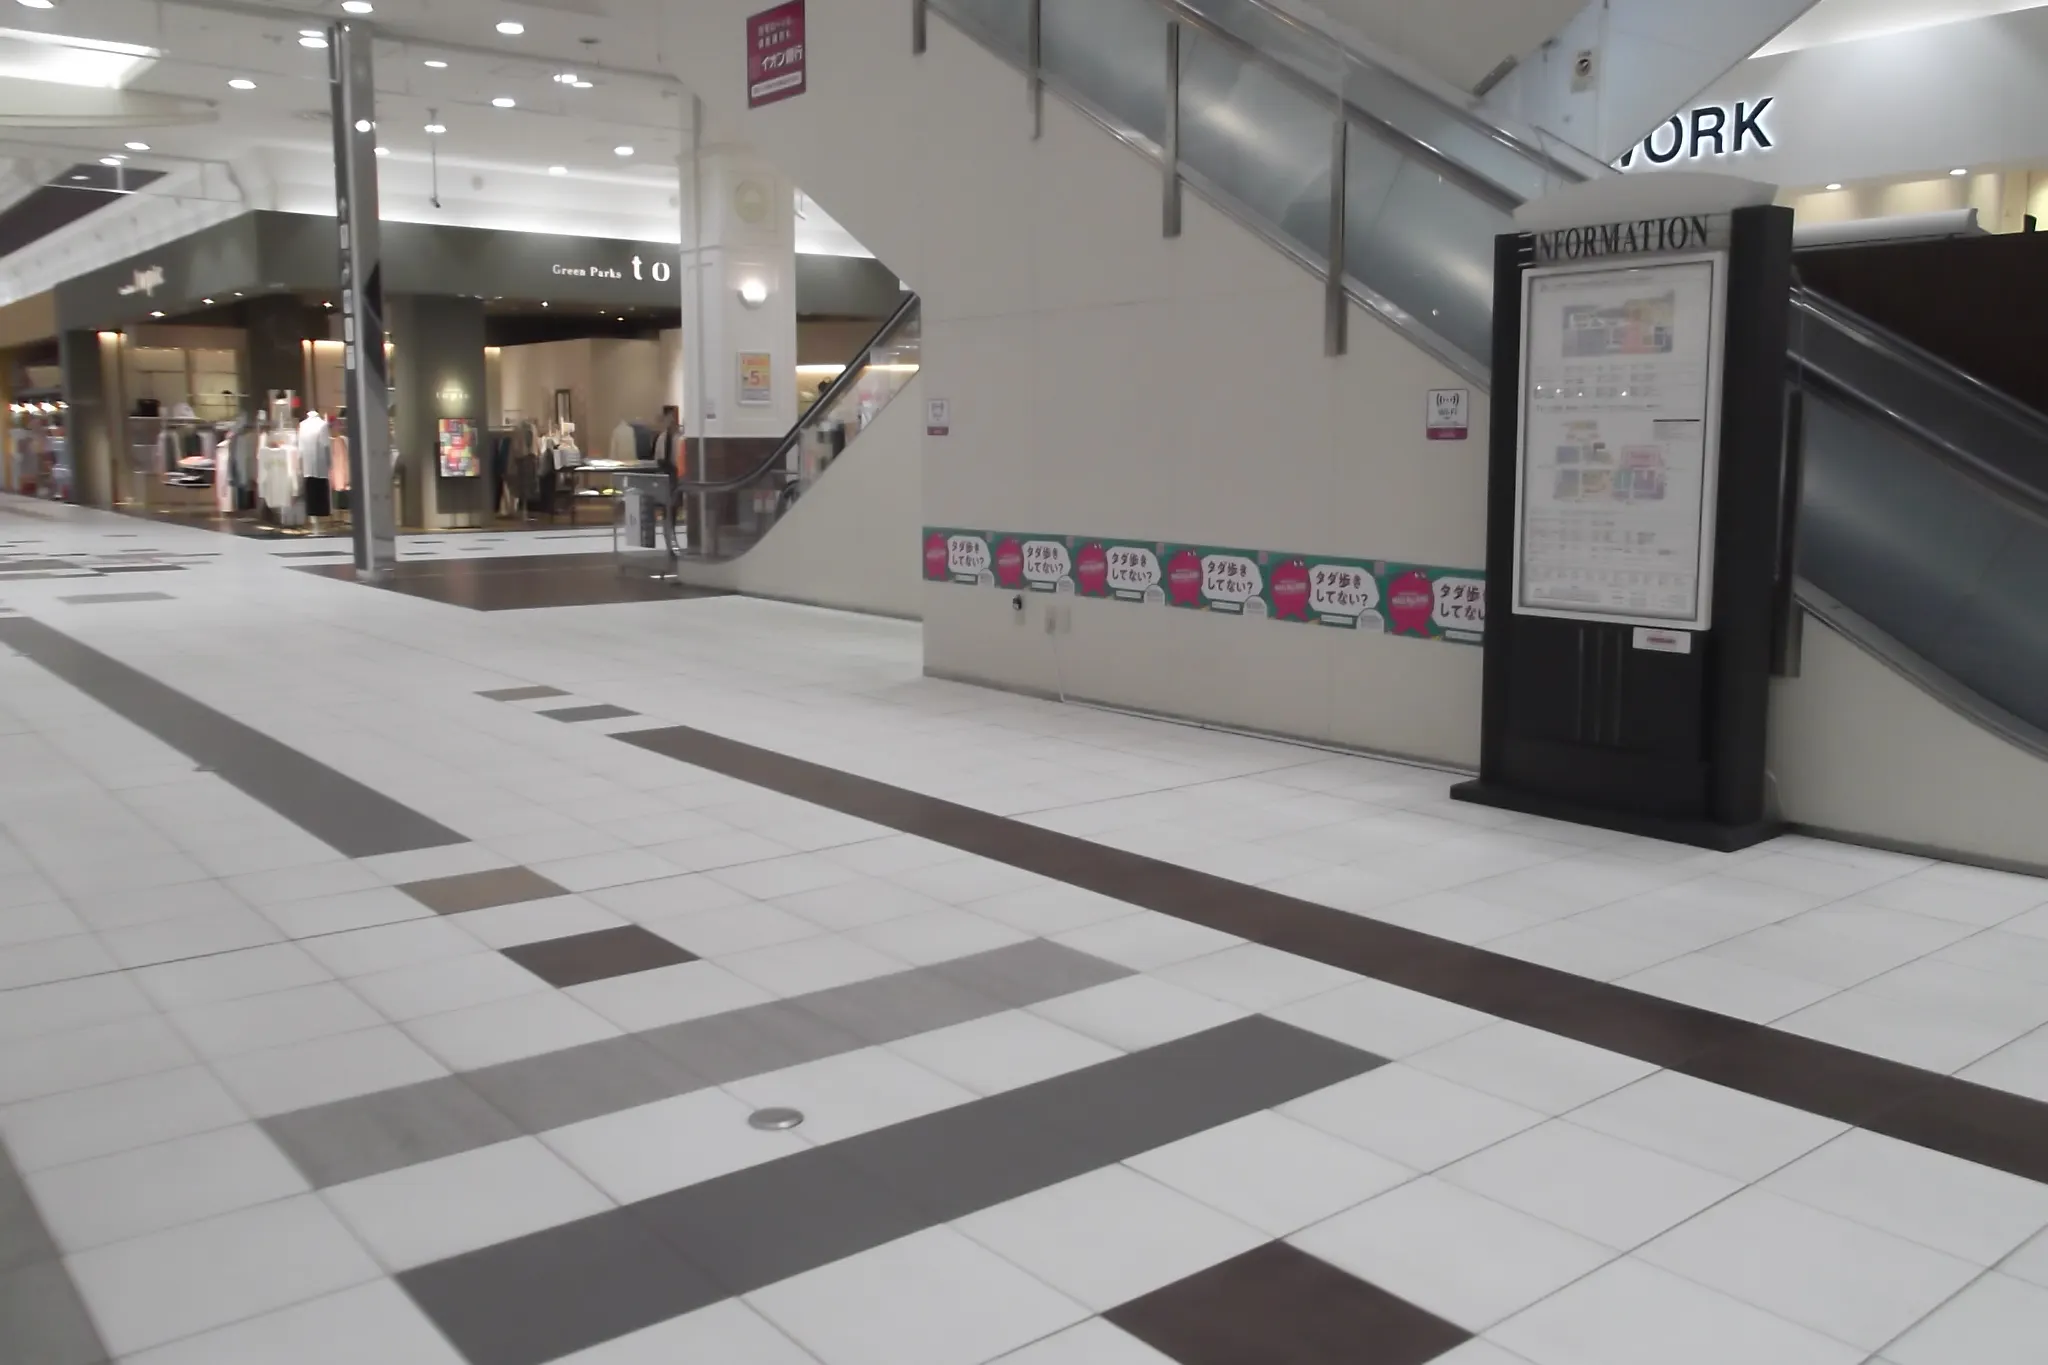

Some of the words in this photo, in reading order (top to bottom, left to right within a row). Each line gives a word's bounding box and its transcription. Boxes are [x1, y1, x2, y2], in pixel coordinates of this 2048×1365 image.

[1620, 97, 1775, 168] ORK
[552, 263, 587, 277] Green
[589, 266, 622, 279] Parks
[1027, 544, 1058, 560] タダ歩き
[1111, 552, 1147, 568] タダ歩き
[1207, 561, 1248, 578] タダ歩き
[1315, 571, 1362, 588] タダ歩き
[1439, 583, 1484, 603] タダ歩
